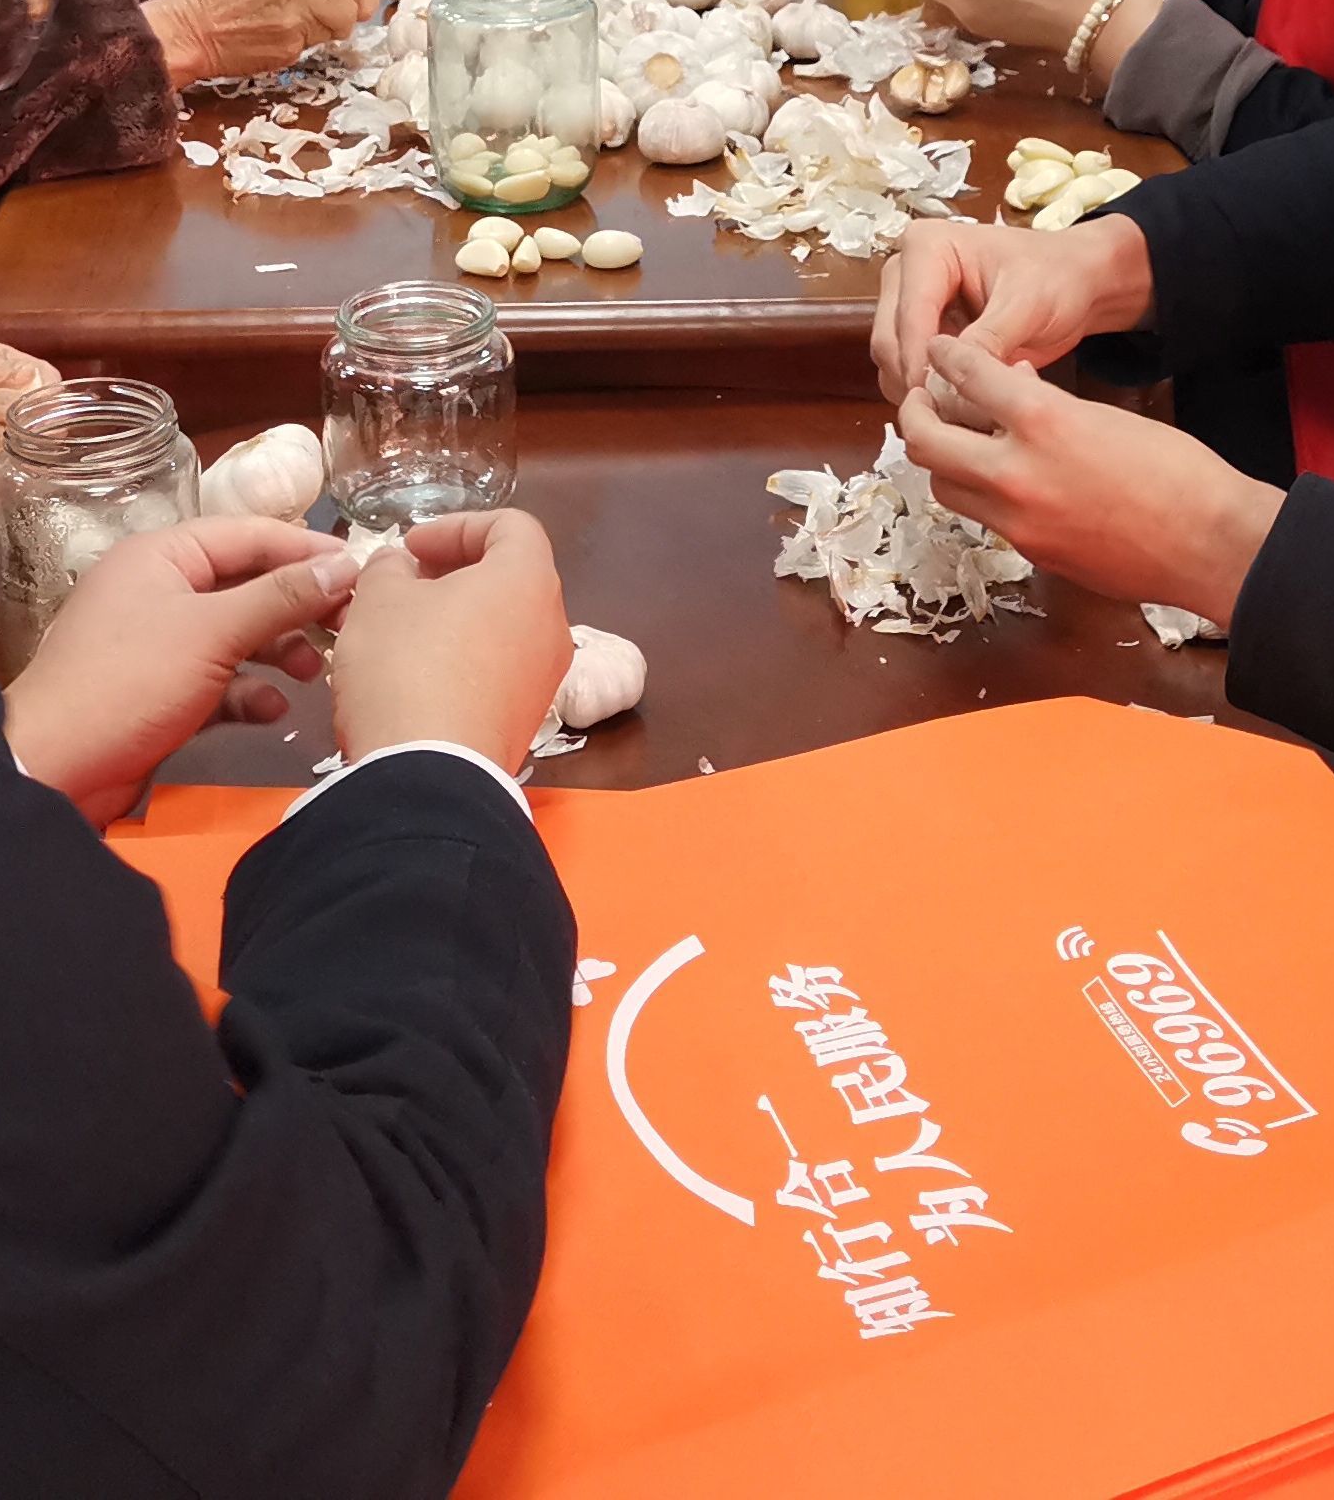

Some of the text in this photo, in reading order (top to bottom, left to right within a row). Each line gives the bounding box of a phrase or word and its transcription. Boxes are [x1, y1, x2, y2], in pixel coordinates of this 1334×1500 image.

[769, 963, 1013, 1246] 为人民服务
[1107, 953, 1275, 1106] 96969
[757, 1094, 954, 1339] 知行合一
